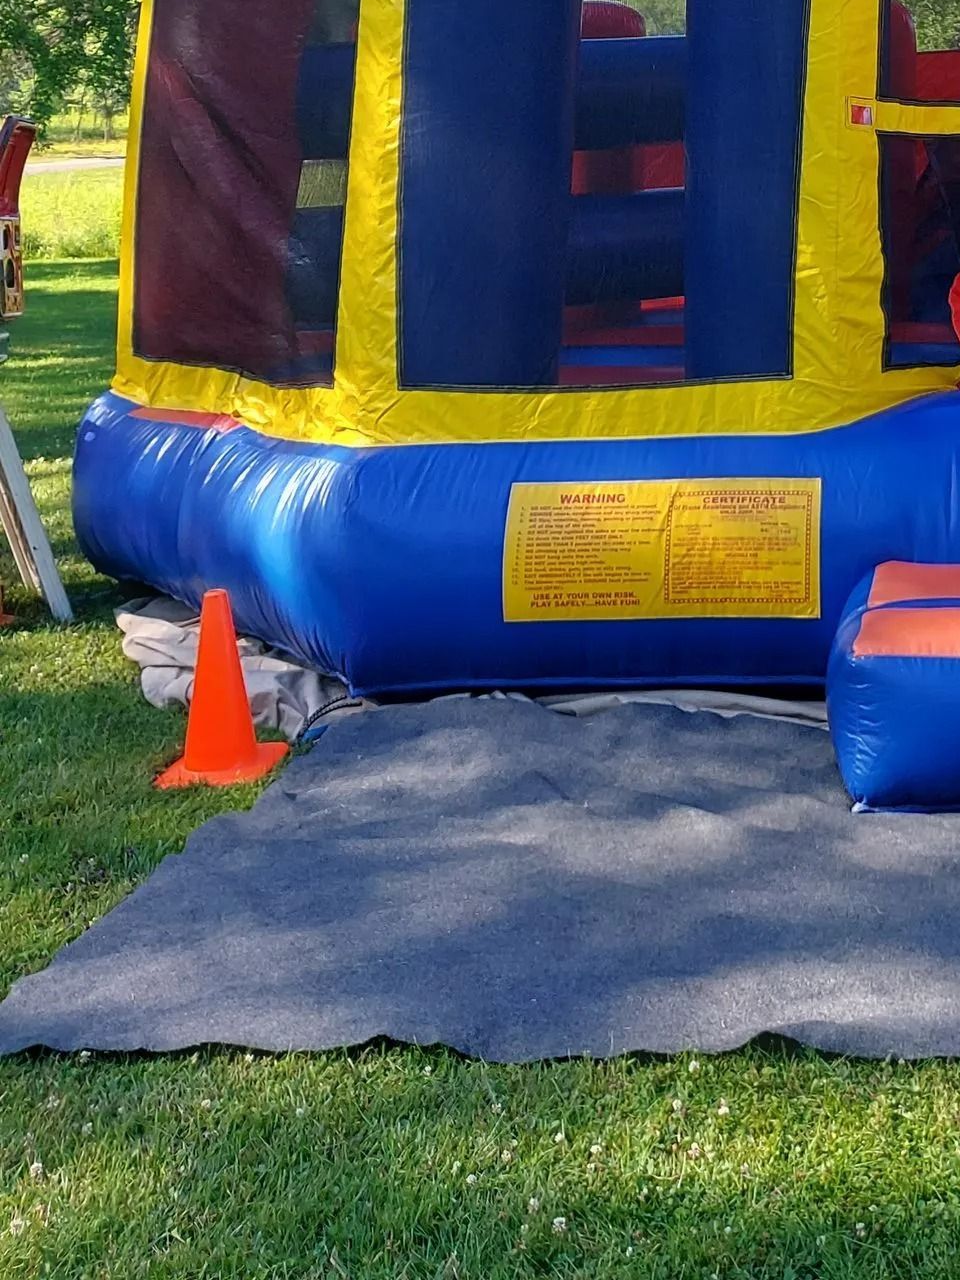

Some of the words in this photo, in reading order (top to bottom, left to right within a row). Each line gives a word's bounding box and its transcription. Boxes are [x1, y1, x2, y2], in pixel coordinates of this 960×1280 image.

[560, 493, 625, 504] WARNING
[702, 496, 786, 504] CERTIFICATE
[533, 592, 550, 600] USE
[553, 592, 563, 600] AT
[566, 592, 590, 600] YOUR
[592, 591, 612, 599] OWN
[530, 600, 551, 608] PLAY
